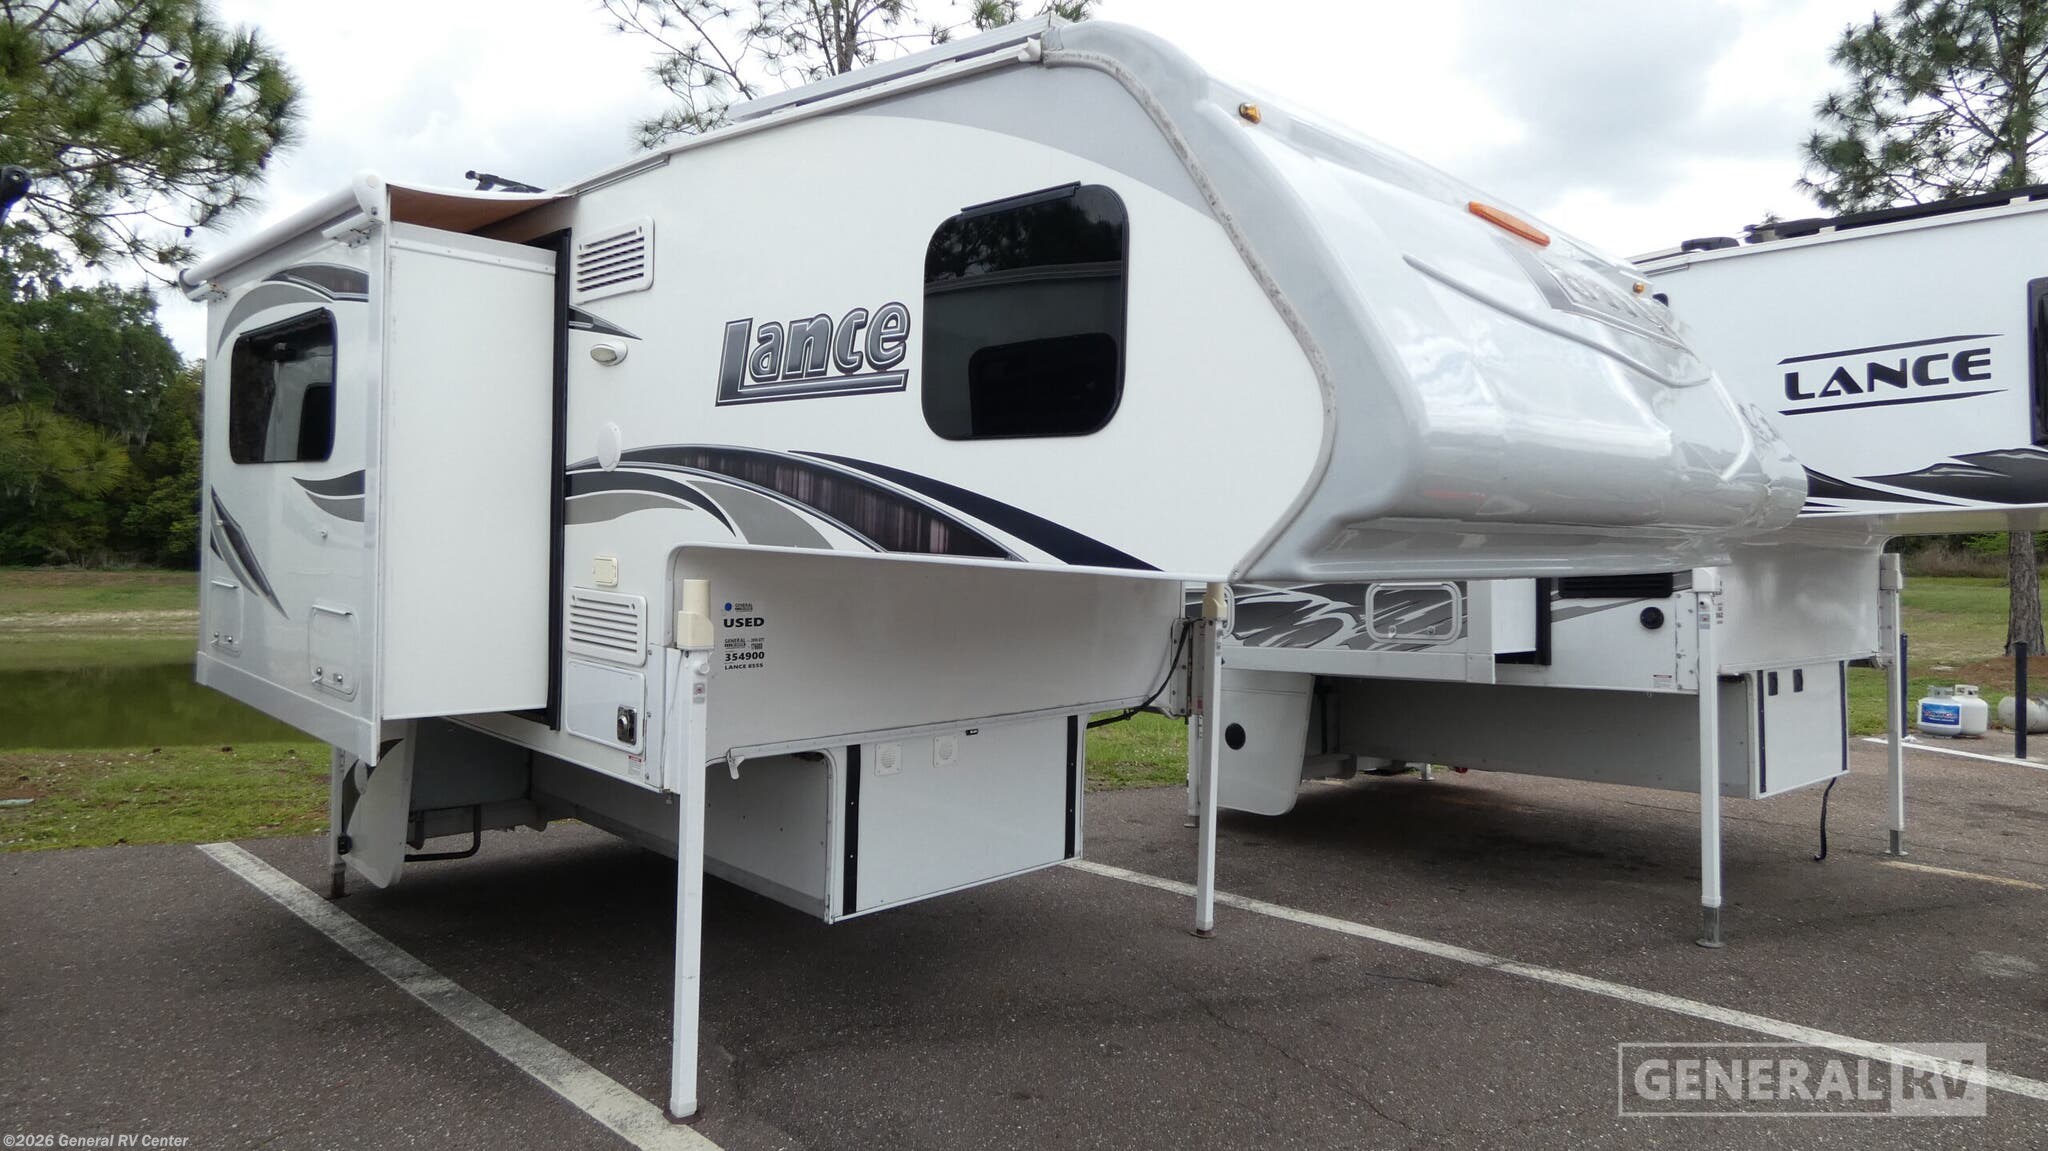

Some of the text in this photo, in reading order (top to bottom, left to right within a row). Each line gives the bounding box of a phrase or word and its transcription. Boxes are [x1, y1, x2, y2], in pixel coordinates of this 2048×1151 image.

[715, 301, 911, 407] Lance
[1784, 347, 1992, 401] LANCE
[723, 617, 765, 628] USED
[725, 651, 765, 661] 354900
